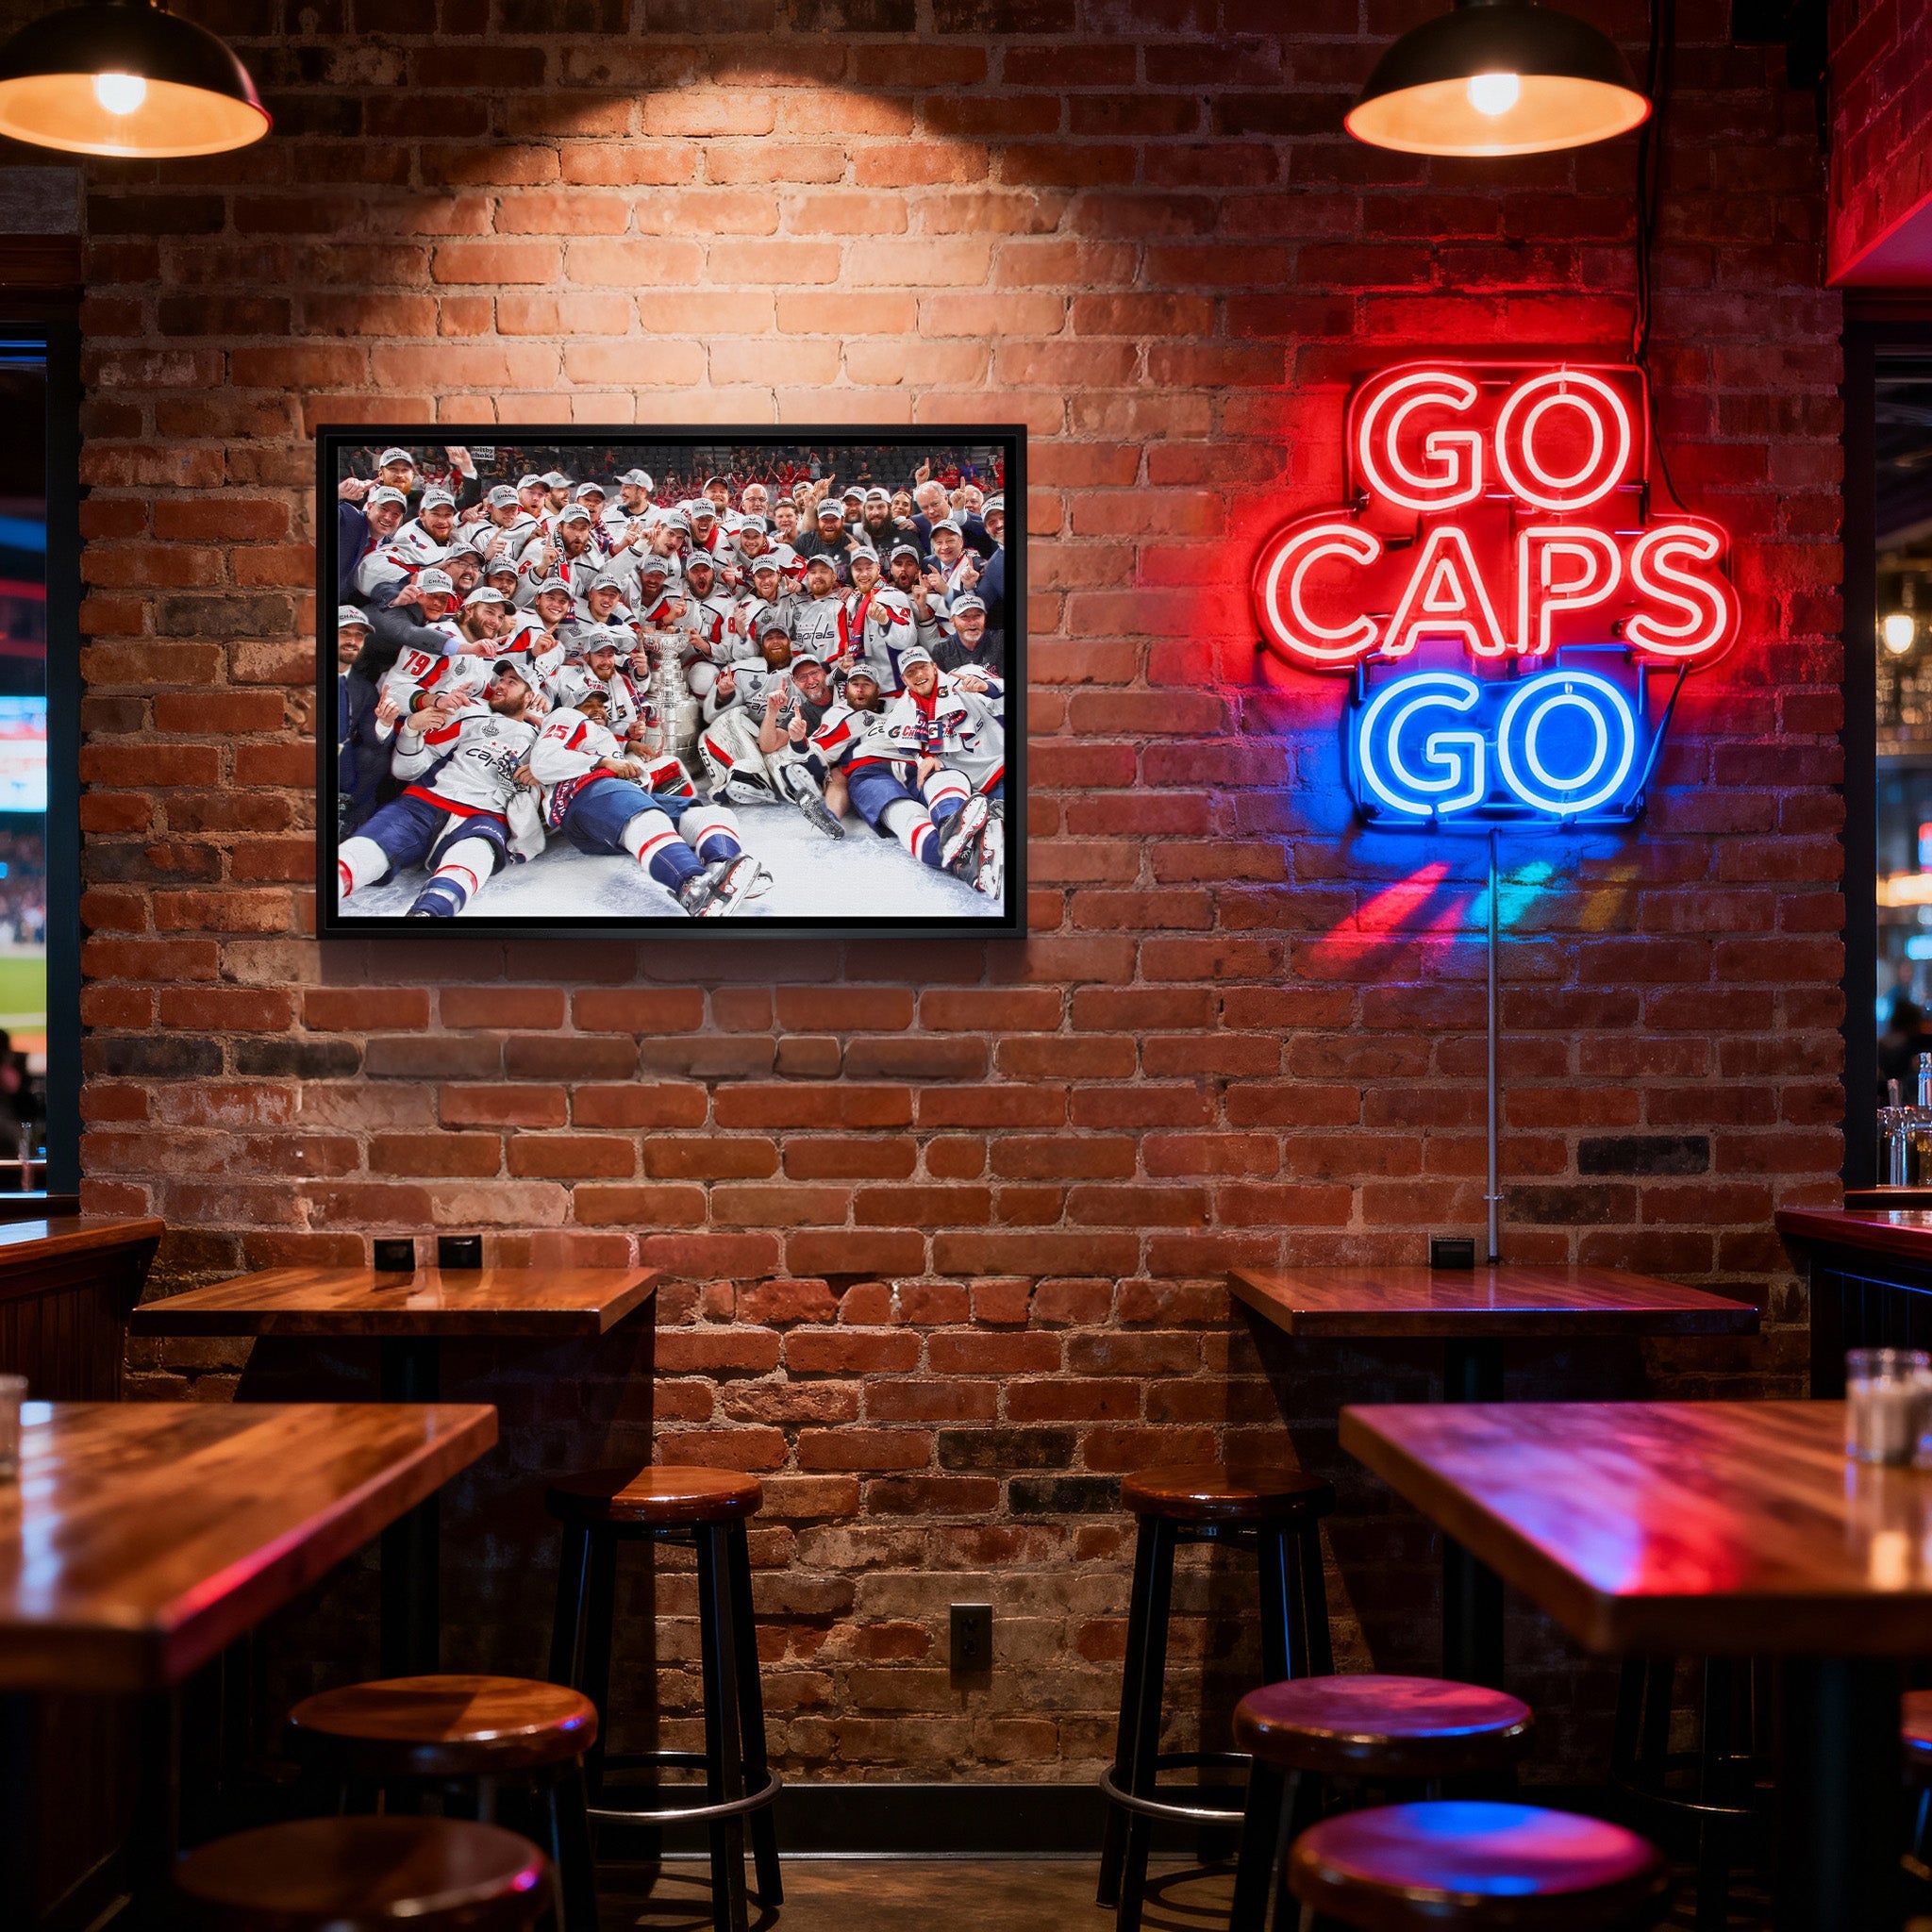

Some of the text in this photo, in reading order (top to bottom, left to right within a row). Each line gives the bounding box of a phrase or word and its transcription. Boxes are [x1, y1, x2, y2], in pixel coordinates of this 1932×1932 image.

[1358, 371, 1631, 511] GO
[1264, 524, 1728, 660] CAPS
[402, 650, 431, 676] 79
[541, 723, 570, 741] 25
[1358, 670, 1635, 817] GO
